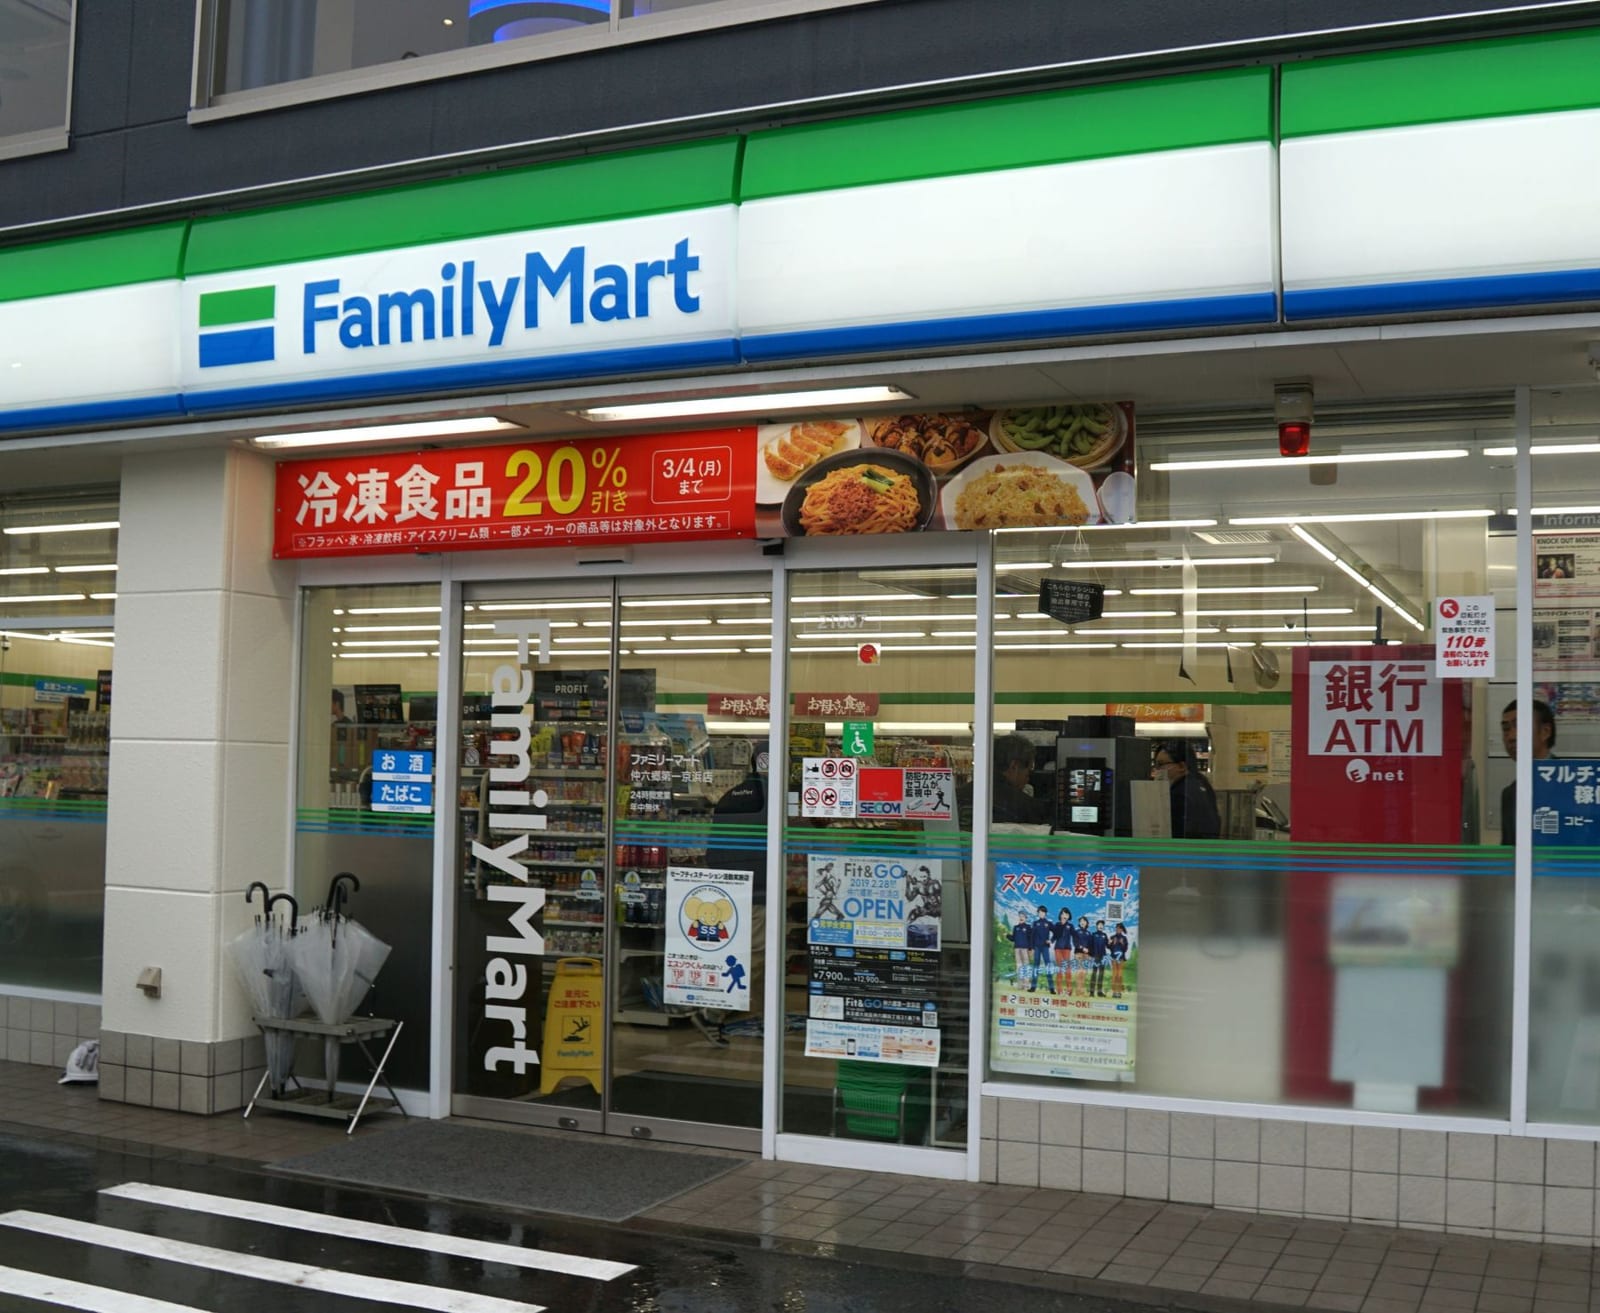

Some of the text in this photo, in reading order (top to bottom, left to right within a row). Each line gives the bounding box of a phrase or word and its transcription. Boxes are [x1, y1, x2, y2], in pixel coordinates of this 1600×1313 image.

[302, 237, 700, 355] FamilyMart
[296, 461, 492, 527] 冷凍食品
[678, 480, 703, 496] まで
[591, 489, 629, 514] 引き
[1446, 635, 1486, 649] 110番
[555, 684, 589, 694] PROFIT
[1325, 663, 1428, 713] 銀行
[808, 694, 866, 715] お母さん食堂
[1324, 718, 1424, 753] ATM
[630, 754, 700, 766] ファミリーマート
[905, 772, 951, 782] 防犯カメラで
[381, 784, 422, 802] たばこ
[630, 790, 671, 800] 24時間営業
[905, 789, 932, 798] 監視中
[860, 802, 901, 814] SECOM
[1564, 816, 1593, 826] コピー
[472, 619, 551, 1075] FamilyMart
[844, 863, 905, 879] Fit&GO
[1001, 870, 1133, 898] スタッフさん募集中!
[843, 897, 904, 919] OPEN
[700, 926, 717, 935] SS
[846, 997, 882, 1009] Fit&GO
